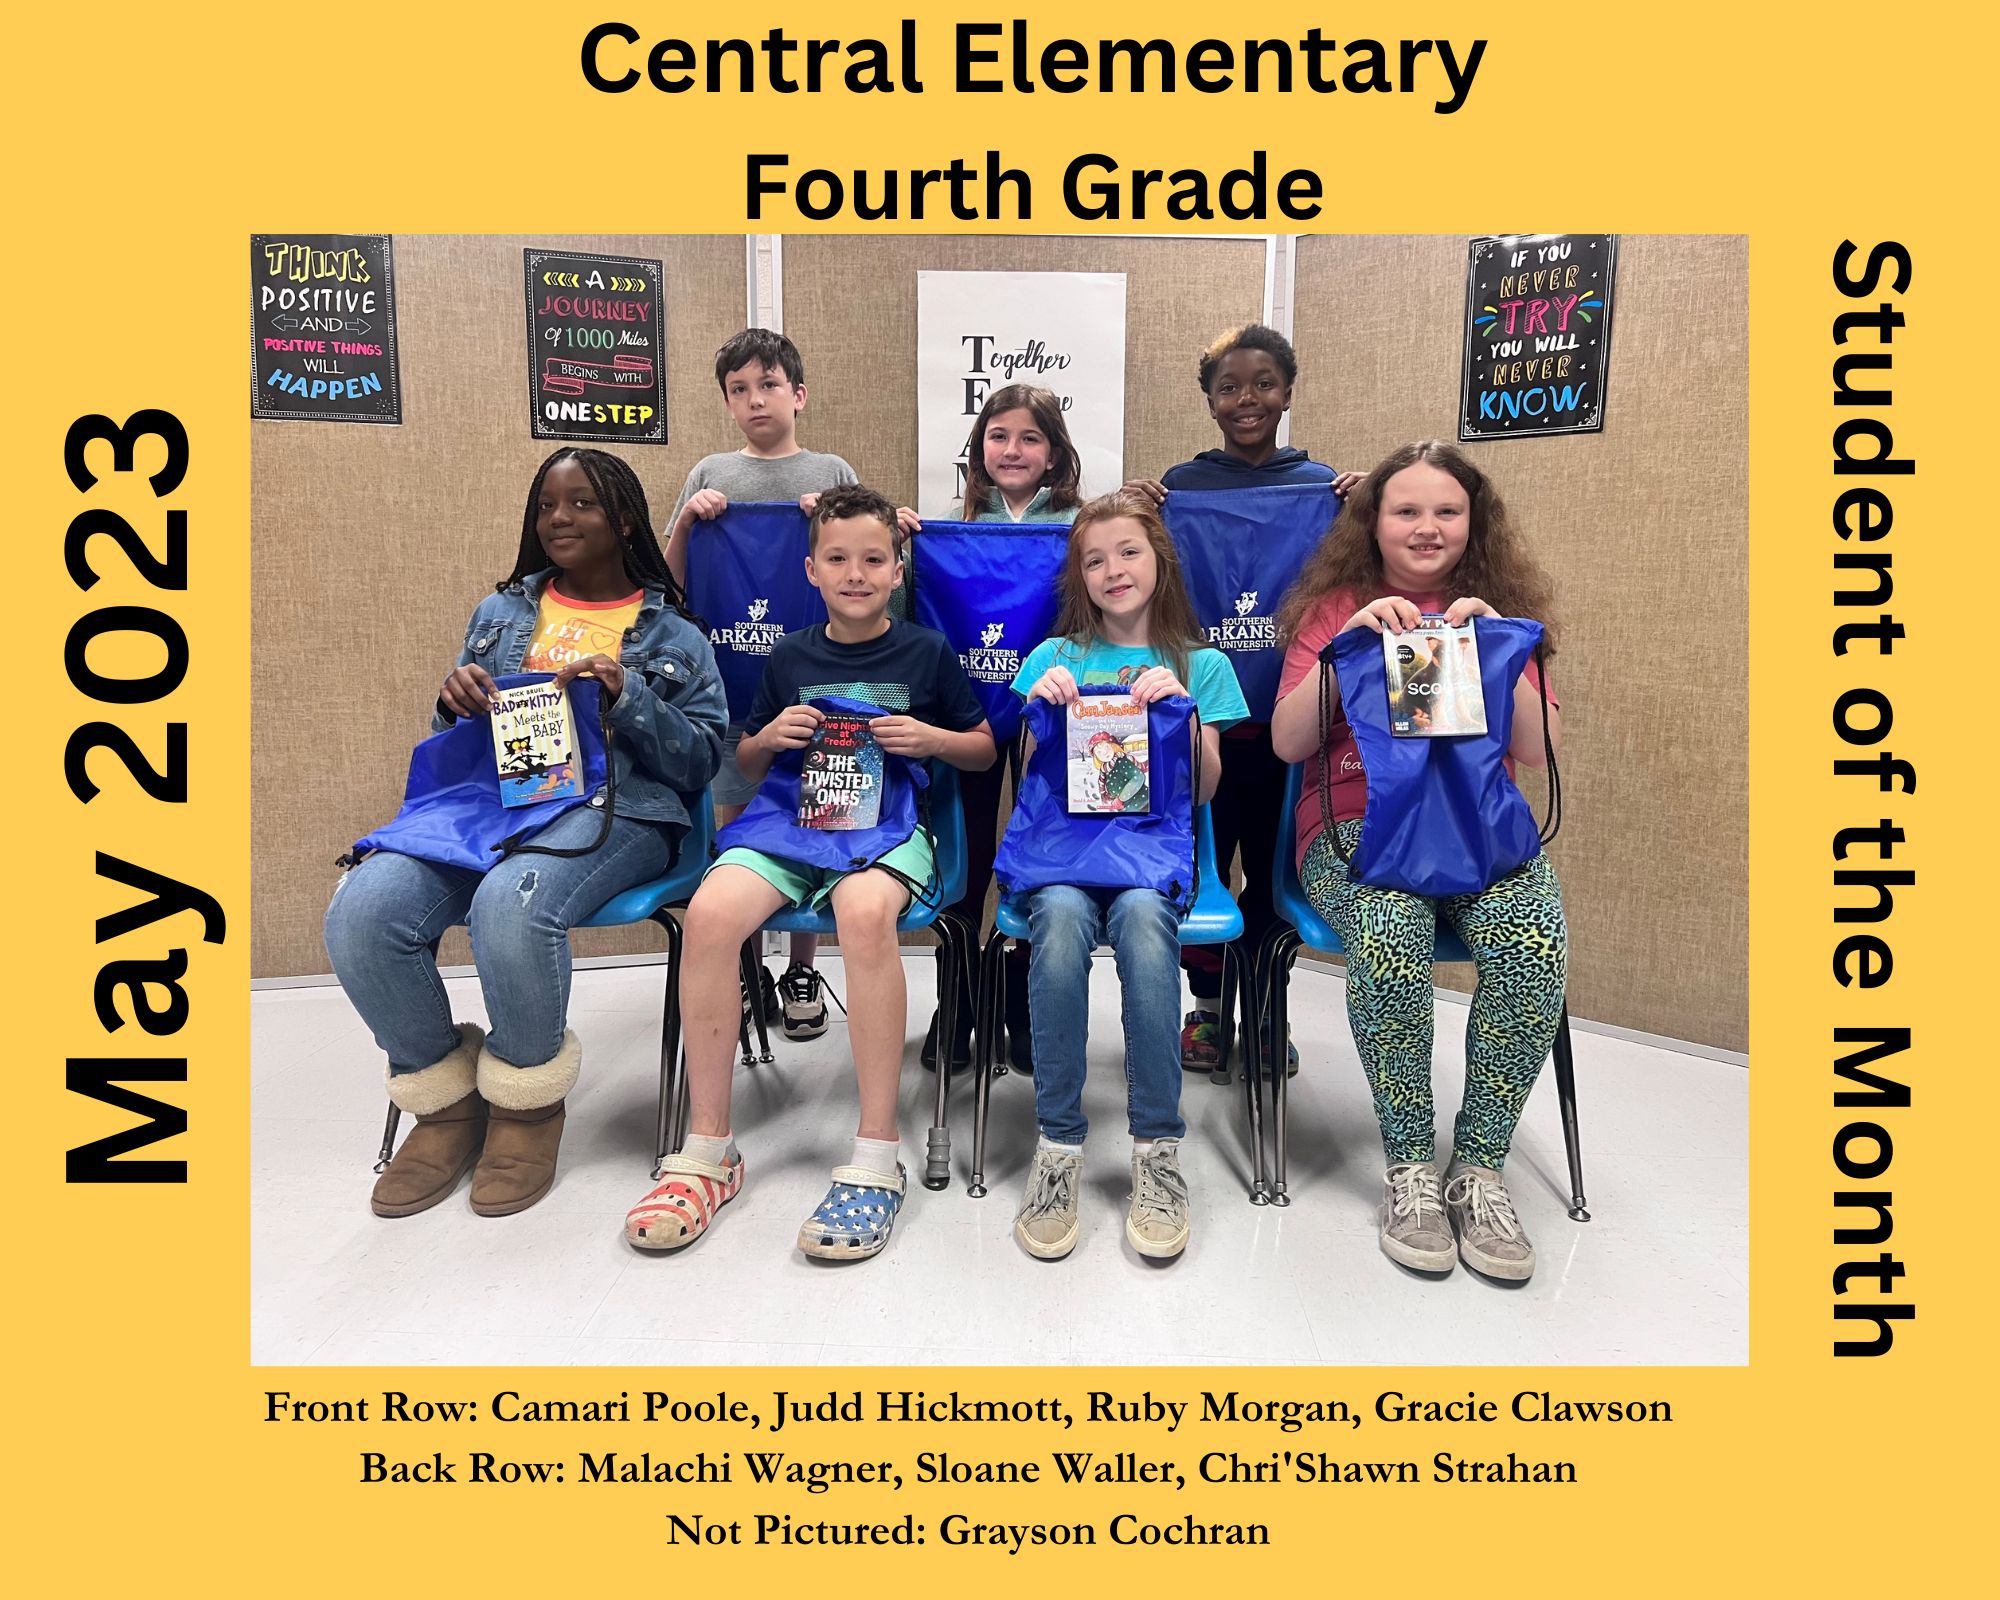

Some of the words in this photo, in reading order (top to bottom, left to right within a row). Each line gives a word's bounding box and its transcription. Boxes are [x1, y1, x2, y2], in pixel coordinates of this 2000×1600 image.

[265, 242, 371, 283] THINK
[1510, 249, 1529, 269] IF
[1538, 242, 1572, 264] YOU
[585, 270, 605, 290] A
[1500, 264, 1580, 299] NEVER
[261, 285, 376, 314] POSITIVE
[538, 295, 650, 322] JOURNEY
[1499, 293, 1579, 335] TRY
[300, 316, 344, 332] AND
[263, 338, 326, 354] POSITIVE
[331, 341, 383, 356] THINGS
[544, 327, 562, 347] Of
[565, 327, 614, 349] 1000
[617, 330, 649, 346] Miles
[1490, 339, 1523, 360] YOU
[1535, 333, 1580, 354] WILL
[303, 358, 344, 374] WILL
[962, 335, 1071, 380] Together
[561, 363, 599, 380] BEGINS
[613, 372, 643, 384] WITH
[1493, 354, 1572, 386] NEVER
[267, 368, 383, 401] HAPPEN
[1479, 381, 1587, 420] KNOW
[545, 401, 592, 422] ONE
[593, 404, 653, 425] STEP
[734, 621, 783, 632] SOUTHERN
[1222, 617, 1273, 626] SOUTHERN
[709, 628, 785, 645] ARKAN
[1200, 625, 1288, 643] RKANS
[732, 643, 772, 653] UNIVERS
[969, 648, 1018, 657] SOUTHERN
[1219, 640, 1276, 649] UNIVERSITY
[548, 646, 595, 665] GO
[959, 654, 1020, 672] RKANS
[492, 700, 516, 716] BAD
[529, 691, 563, 710] KITTY
[509, 690, 524, 698] NICK
[513, 712, 545, 728] Meets
[547, 710, 561, 719] the
[532, 719, 564, 738] BABY
[840, 730, 850, 738] at
[826, 754, 857, 772] THE
[806, 770, 874, 789] TWISTED
[816, 788, 861, 806] ONES
